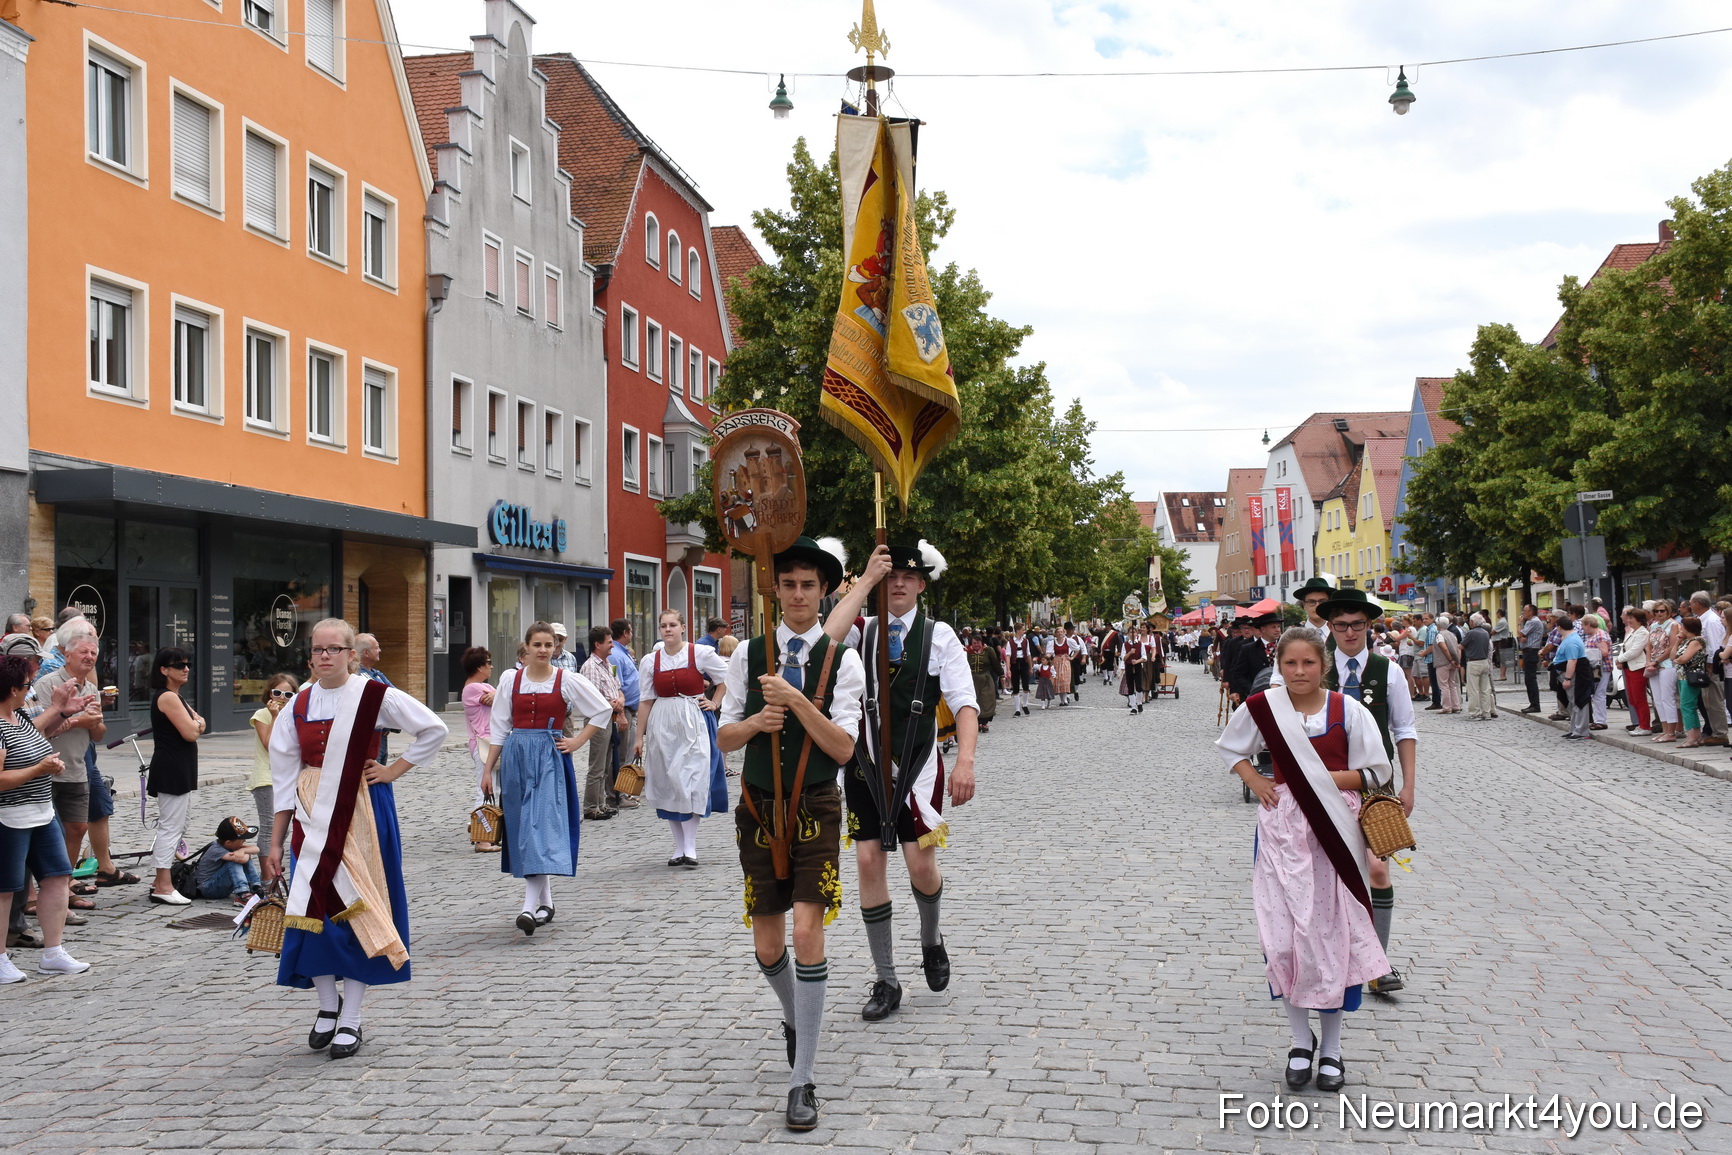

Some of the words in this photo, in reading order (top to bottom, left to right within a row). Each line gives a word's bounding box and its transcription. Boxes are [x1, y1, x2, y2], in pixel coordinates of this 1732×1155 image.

[714, 413, 790, 439] PARSBERG
[761, 497, 797, 511] STADT
[492, 499, 553, 551] Eilles
[74, 601, 98, 614] Dianas
[276, 607, 292, 619] Dianas
